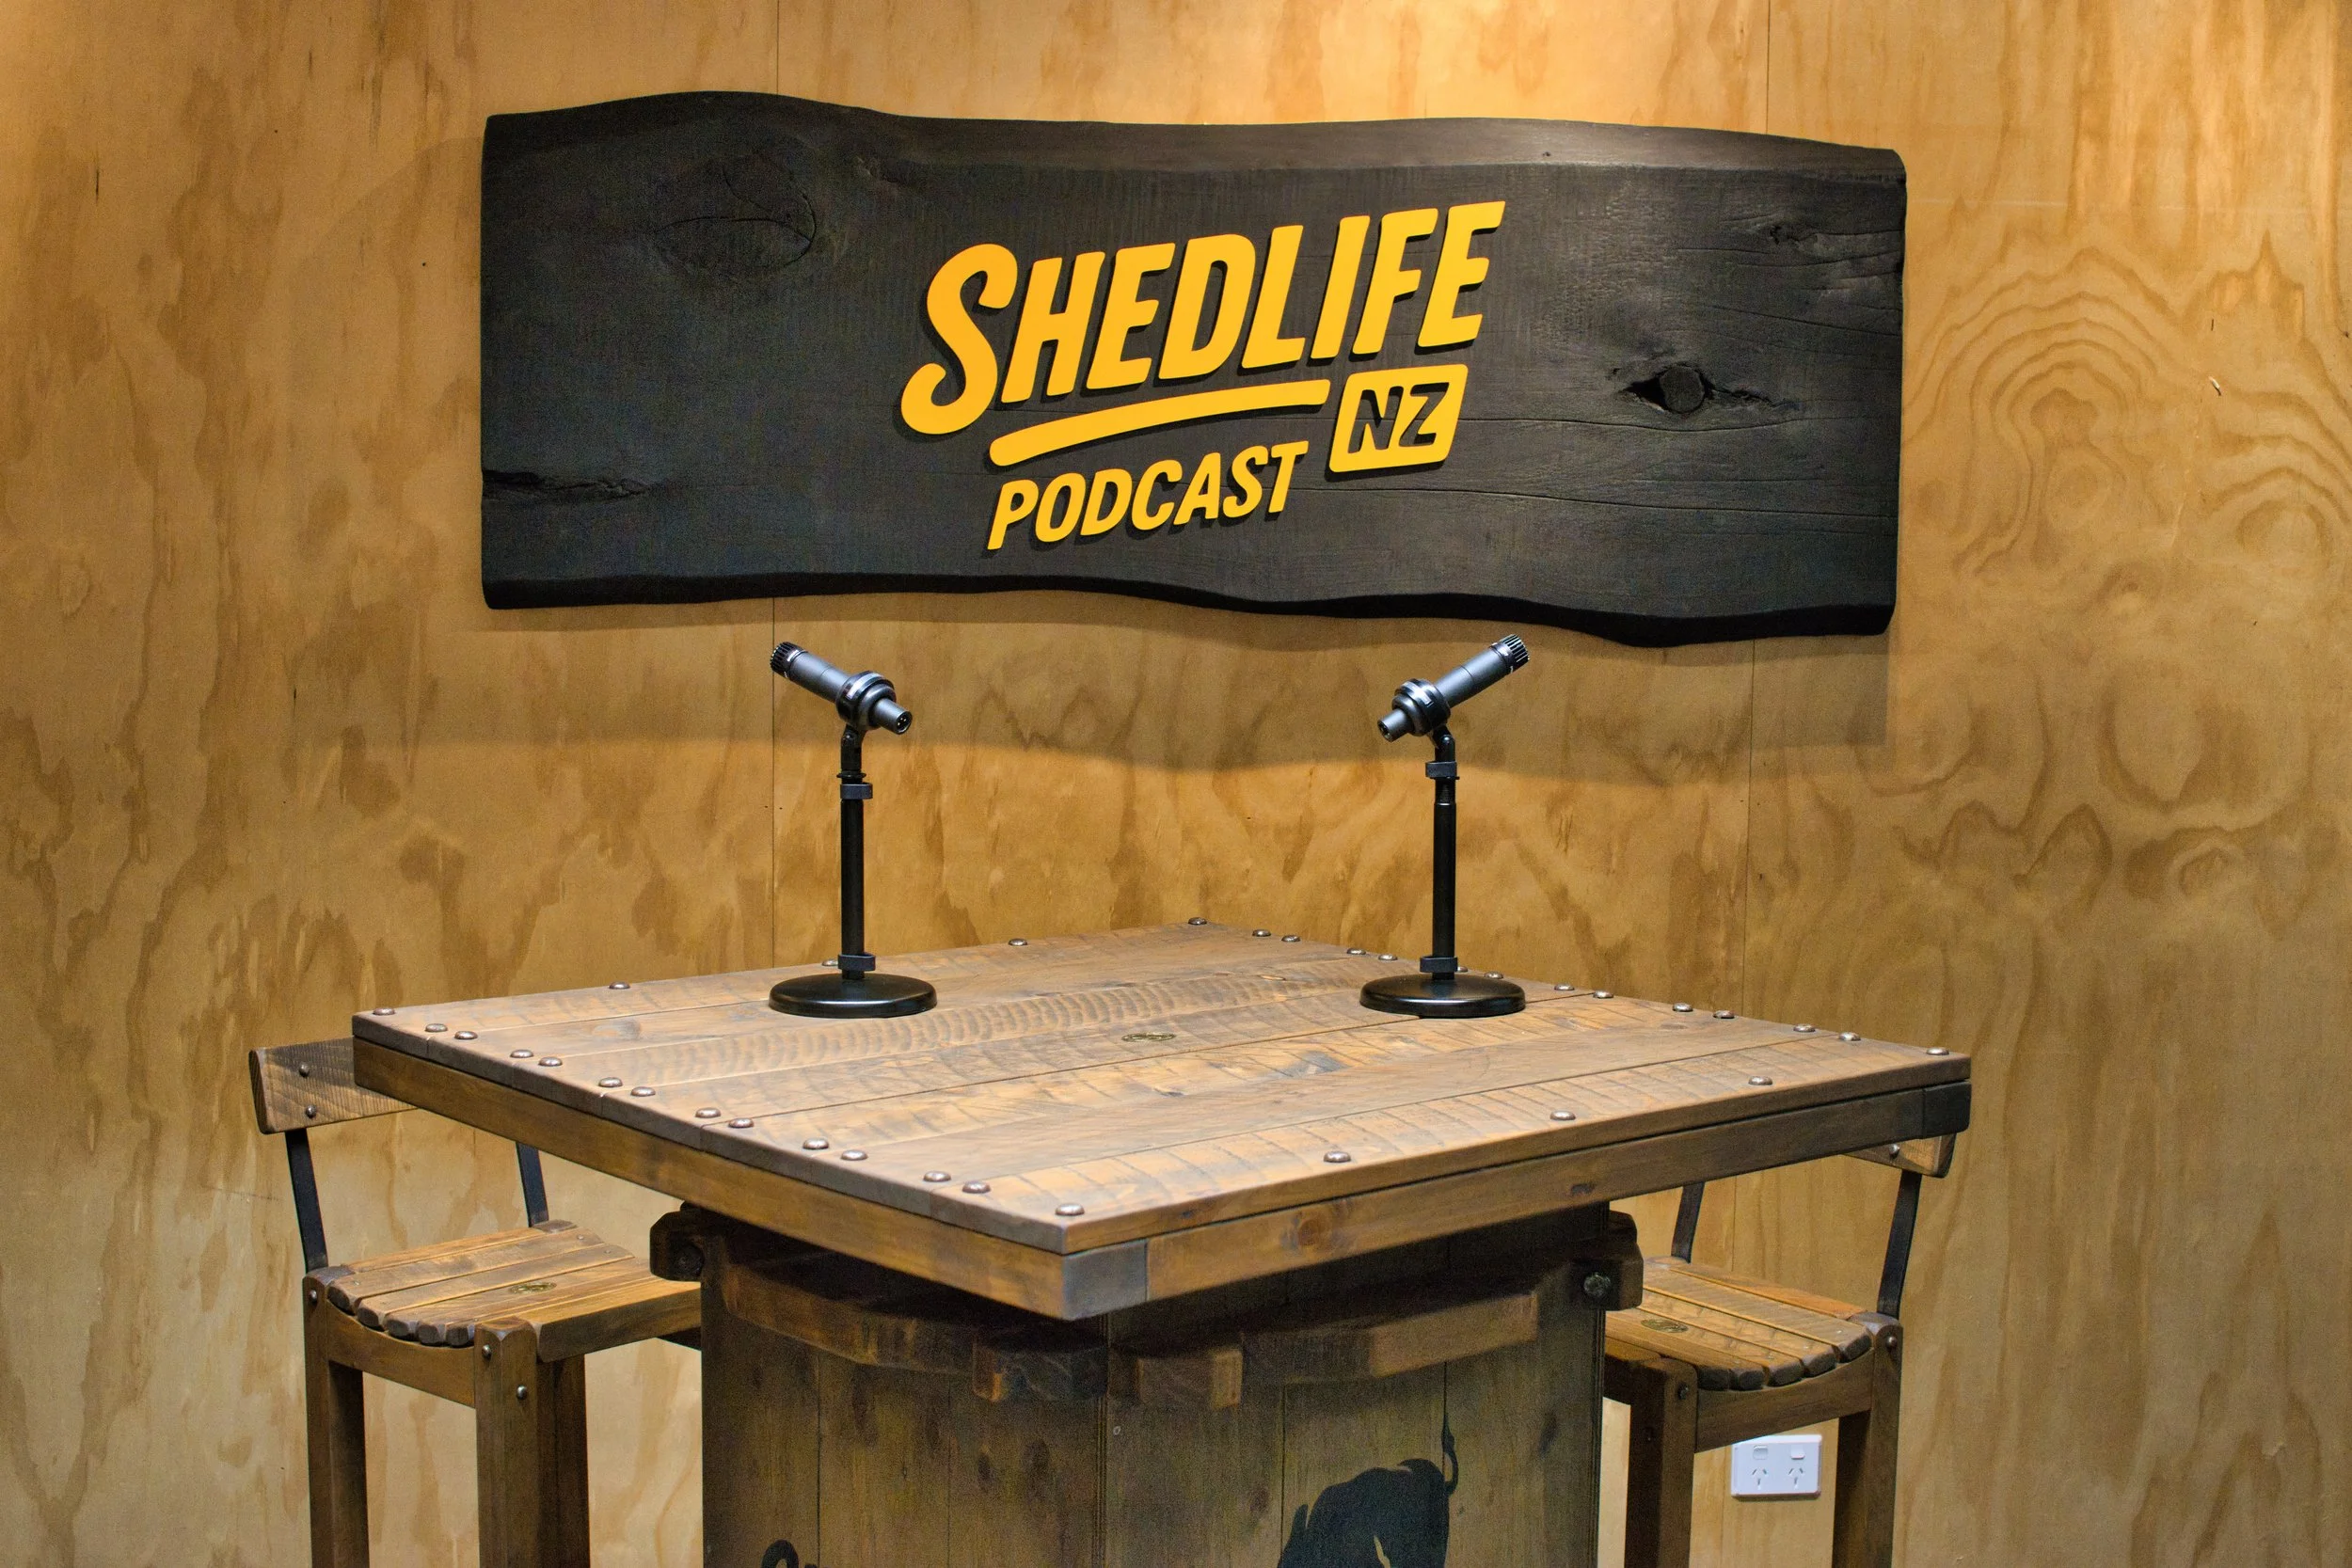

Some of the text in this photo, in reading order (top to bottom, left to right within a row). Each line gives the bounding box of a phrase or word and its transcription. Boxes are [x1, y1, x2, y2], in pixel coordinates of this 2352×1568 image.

[900, 198, 1506, 435] SHEDLIFE
[1346, 380, 1452, 455] NZ
[987, 439, 1310, 550] PODCAST
